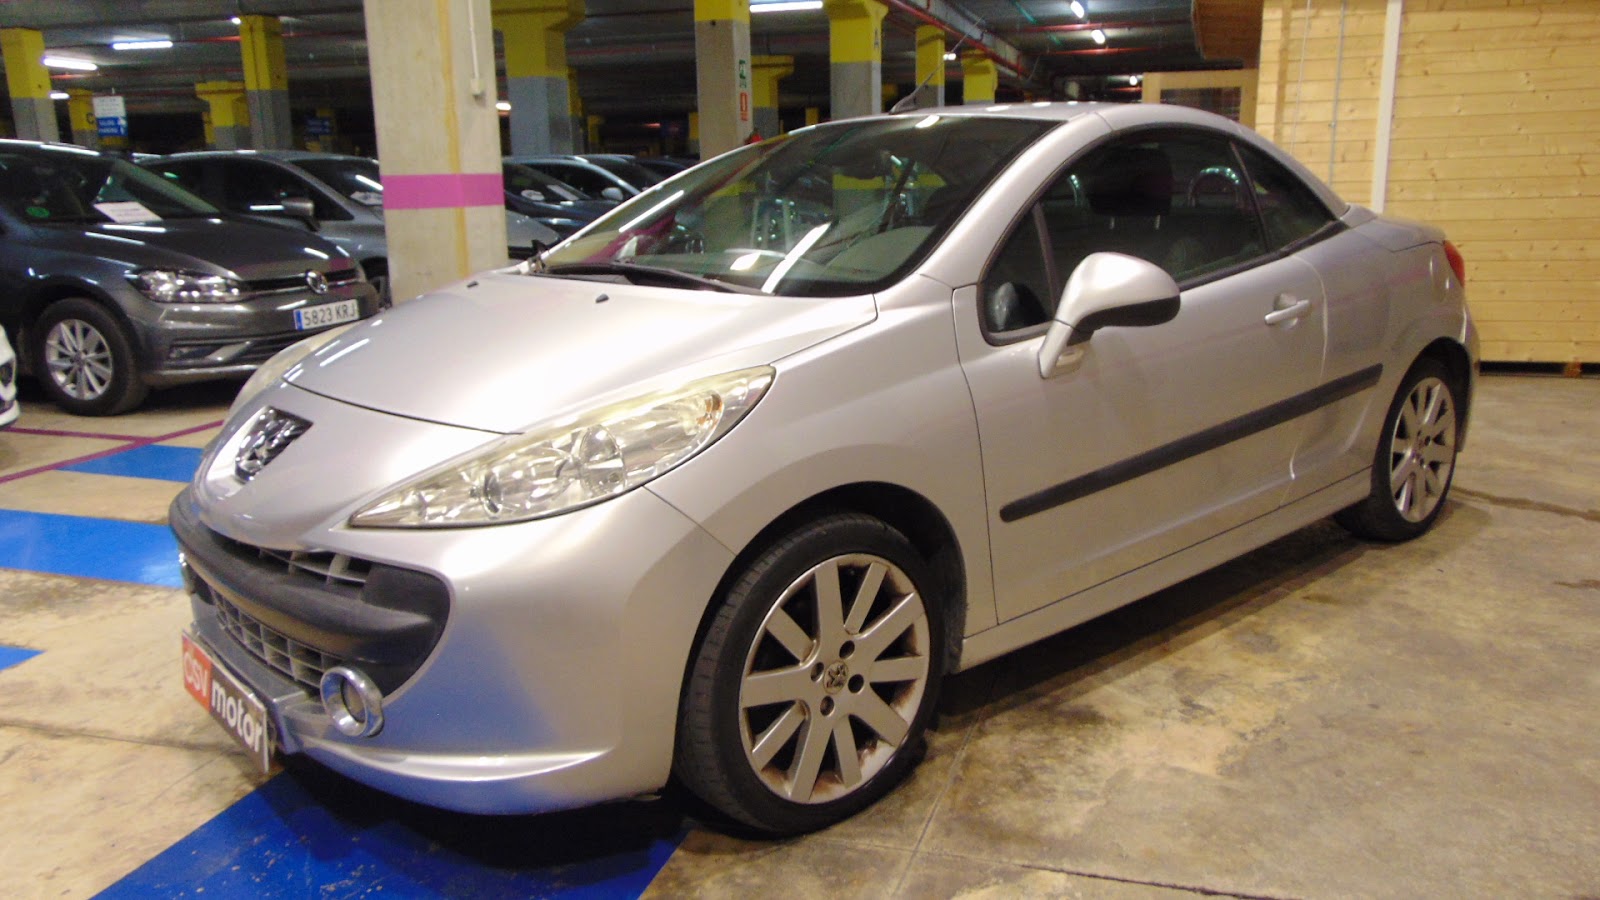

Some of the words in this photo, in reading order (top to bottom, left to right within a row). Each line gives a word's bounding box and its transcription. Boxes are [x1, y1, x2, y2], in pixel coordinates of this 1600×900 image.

[303, 307, 332, 325] 5823
[334, 304, 356, 319] KRJ
[212, 680, 262, 752] motor
